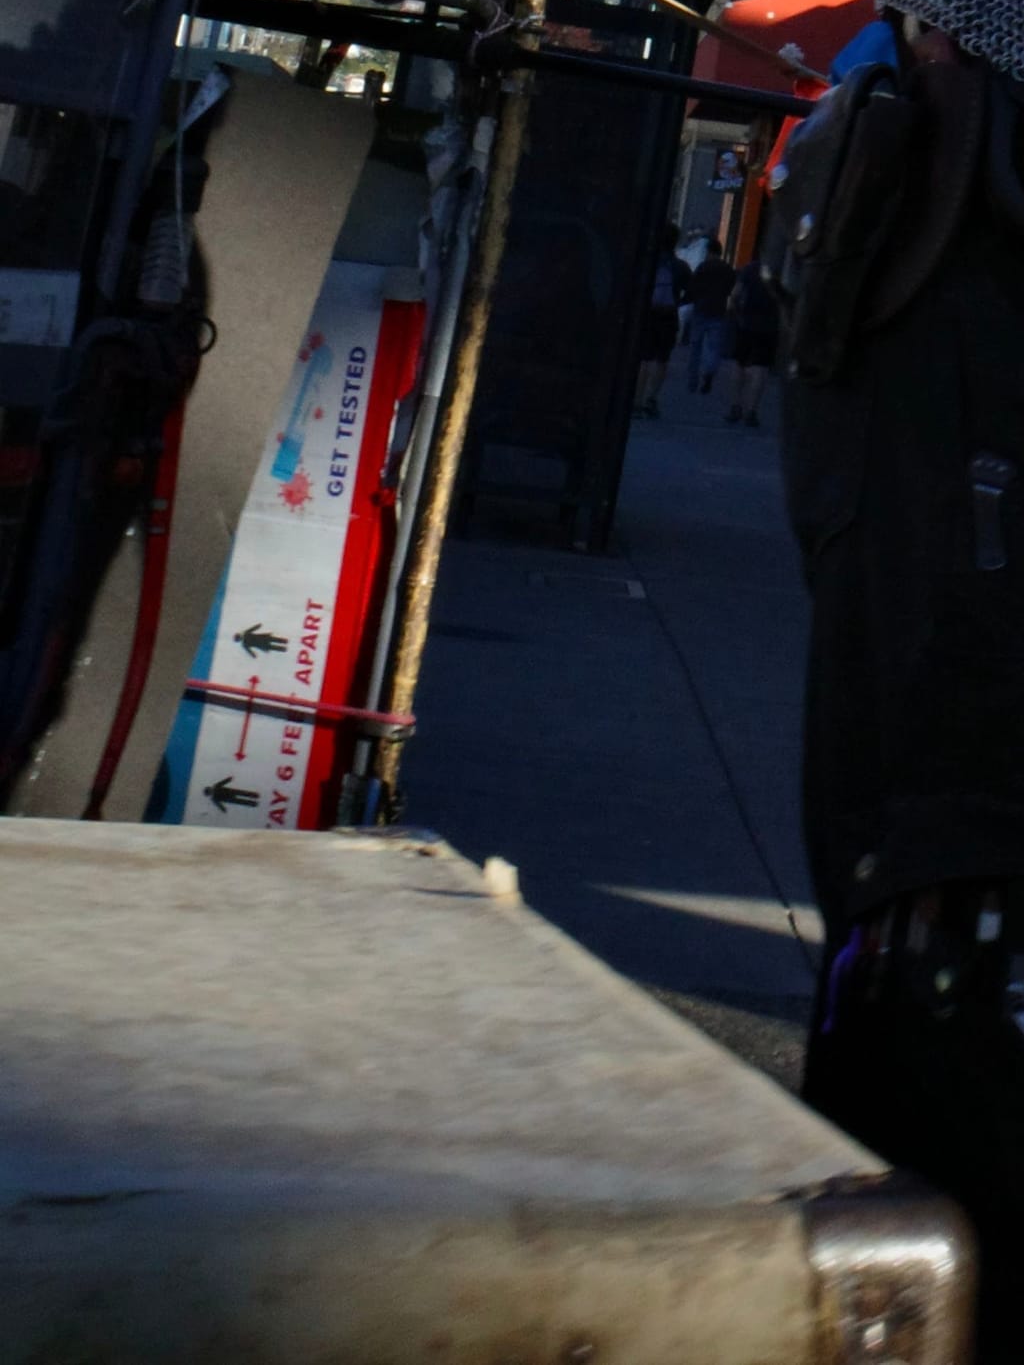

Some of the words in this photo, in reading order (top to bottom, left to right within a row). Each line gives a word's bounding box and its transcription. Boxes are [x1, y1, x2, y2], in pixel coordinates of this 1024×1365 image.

[336, 346, 368, 440] TESTED
[327, 448, 349, 497] GET
[276, 765, 295, 782] 6
[294, 598, 324, 686] APART
